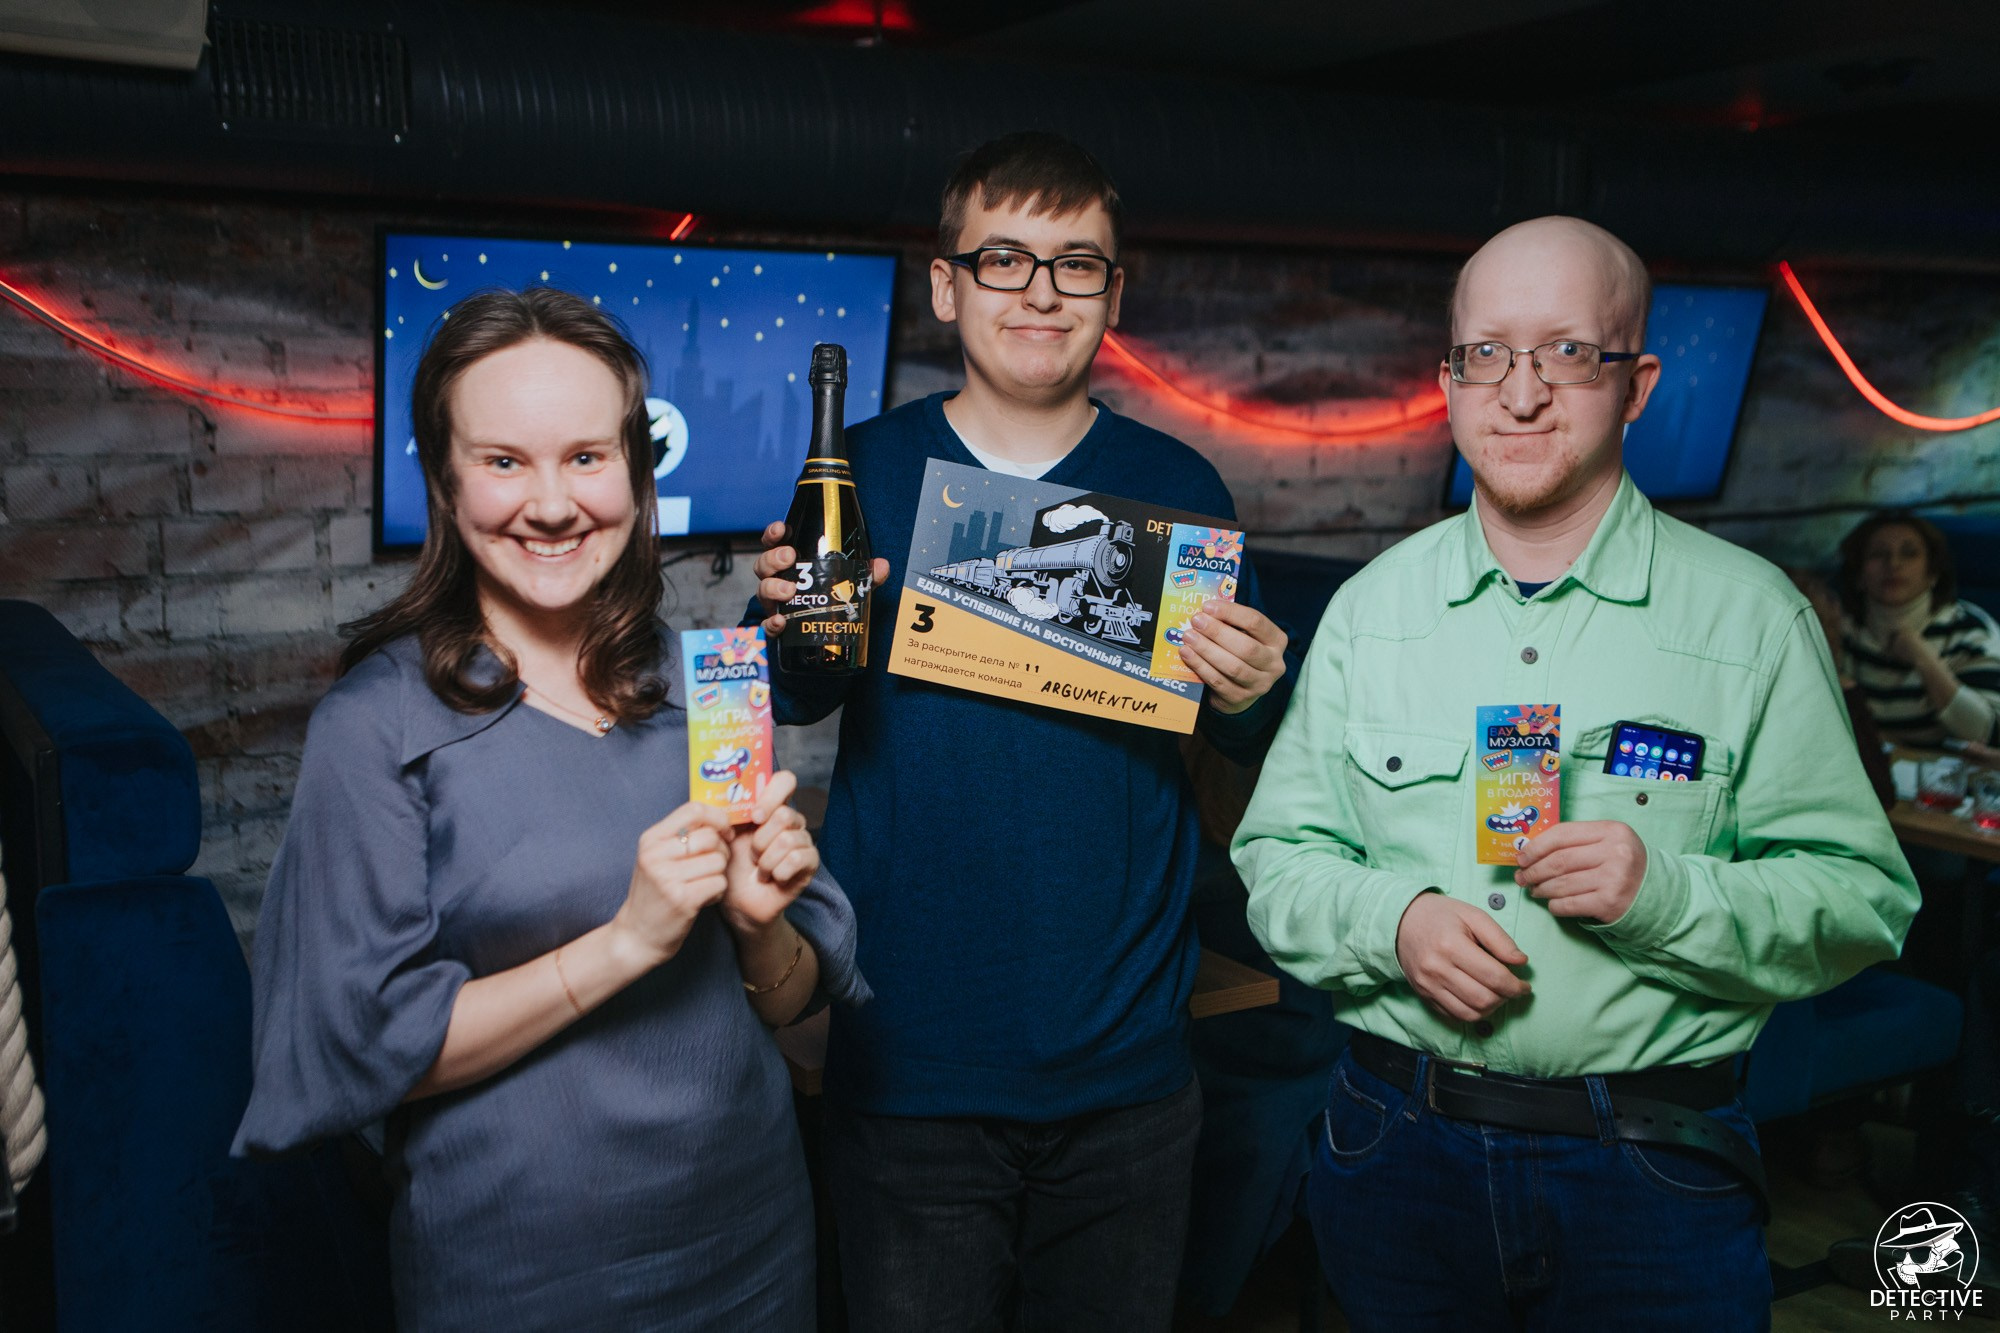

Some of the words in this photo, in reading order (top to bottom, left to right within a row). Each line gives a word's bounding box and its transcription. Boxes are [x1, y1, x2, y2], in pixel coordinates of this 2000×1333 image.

[1179, 556, 1232, 572] МУЗЛОТА
[796, 562, 814, 591] 3
[910, 603, 936, 633] 3
[916, 577, 950, 599] ЕДВА
[953, 591, 1022, 627] УСПЕВШИЕ
[1022, 620, 1041, 636] НА
[1043, 629, 1123, 668] ВОСТОЧНЫЙ
[802, 621, 864, 634] DETECTIVE
[814, 634, 857, 642] PARTY
[907, 638, 920, 648] За
[921, 642, 978, 662] раскрытие
[979, 655, 1005, 668] дела
[1008, 661, 1020, 670] №
[696, 664, 758, 681] МУЗЛОТА
[904, 656, 975, 679] награждается
[978, 673, 1023, 689] команда
[1041, 680, 1158, 714] ARGUMENTUM
[710, 708, 753, 725] ИГРА
[1489, 726, 1514, 737] ВАУ
[1489, 736, 1552, 748] МУЗЛОТА
[1499, 772, 1542, 785] ИГРА
[1487, 788, 1495, 798] В
[1498, 787, 1554, 799] ПОДАРОК
